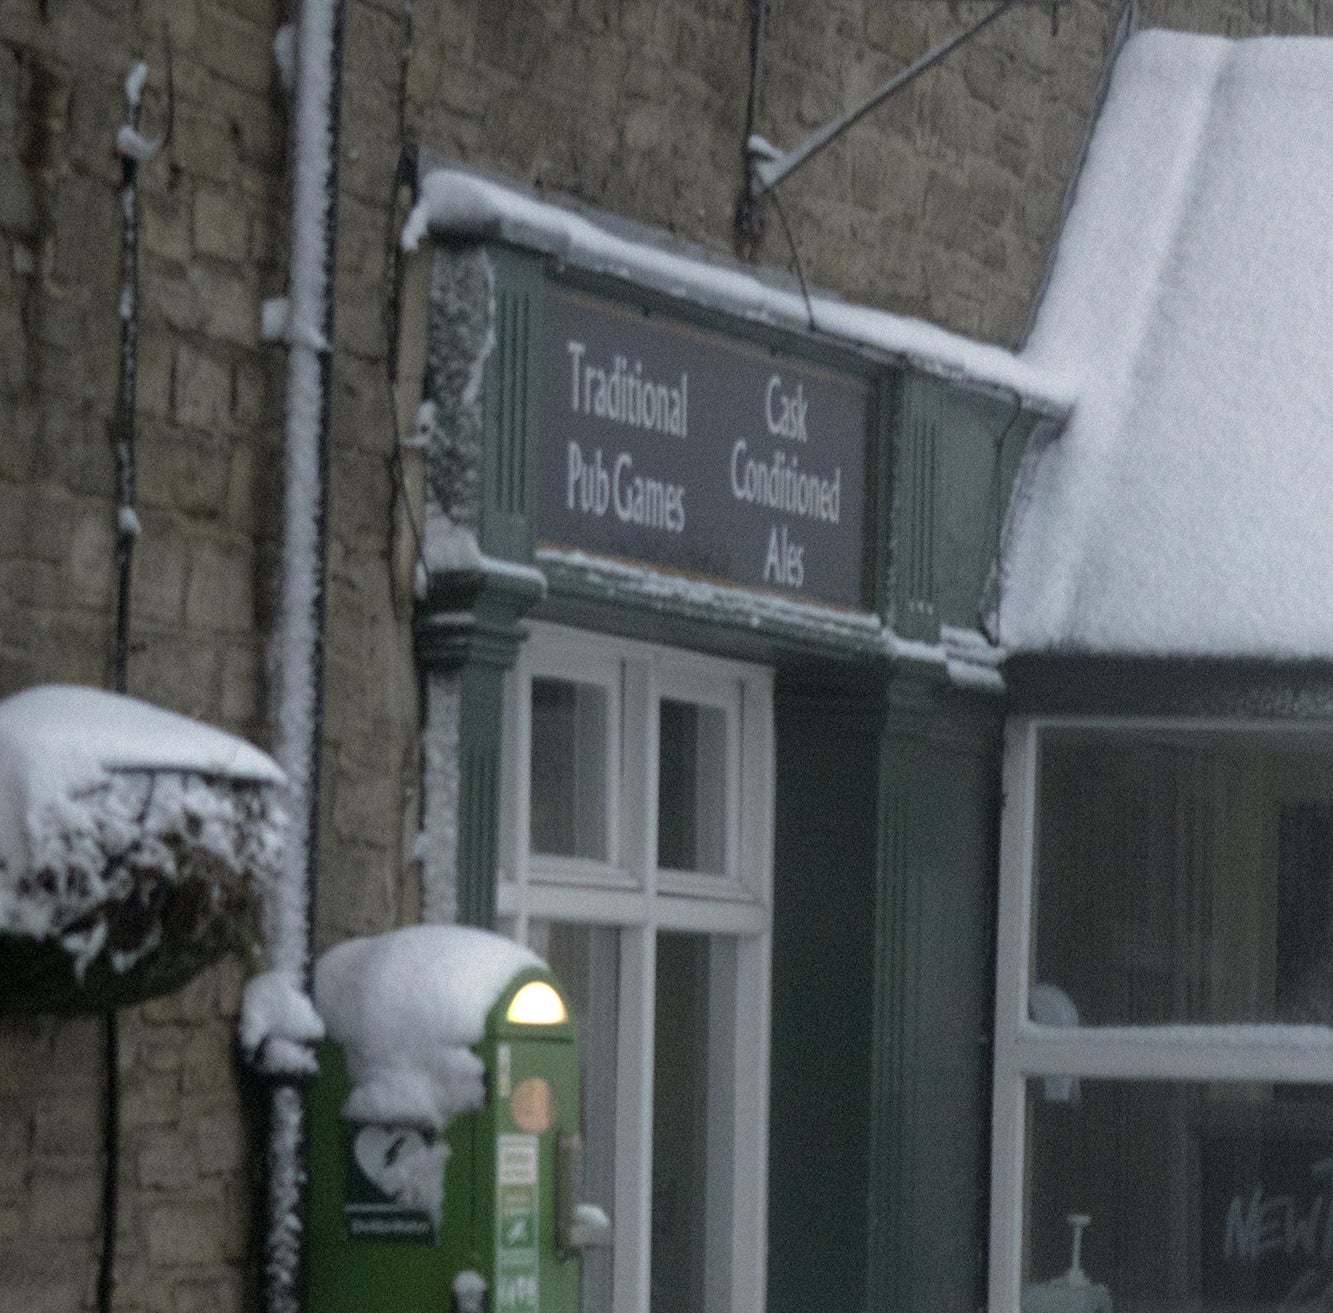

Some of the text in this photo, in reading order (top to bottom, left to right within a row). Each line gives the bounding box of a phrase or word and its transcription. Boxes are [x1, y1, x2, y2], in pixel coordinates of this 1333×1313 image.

[568, 342, 687, 438] Traditional
[765, 375, 808, 442] Cask
[567, 441, 685, 532] Pub Games
[730, 439, 841, 524] Conditioned
[764, 525, 804, 587] Ales
